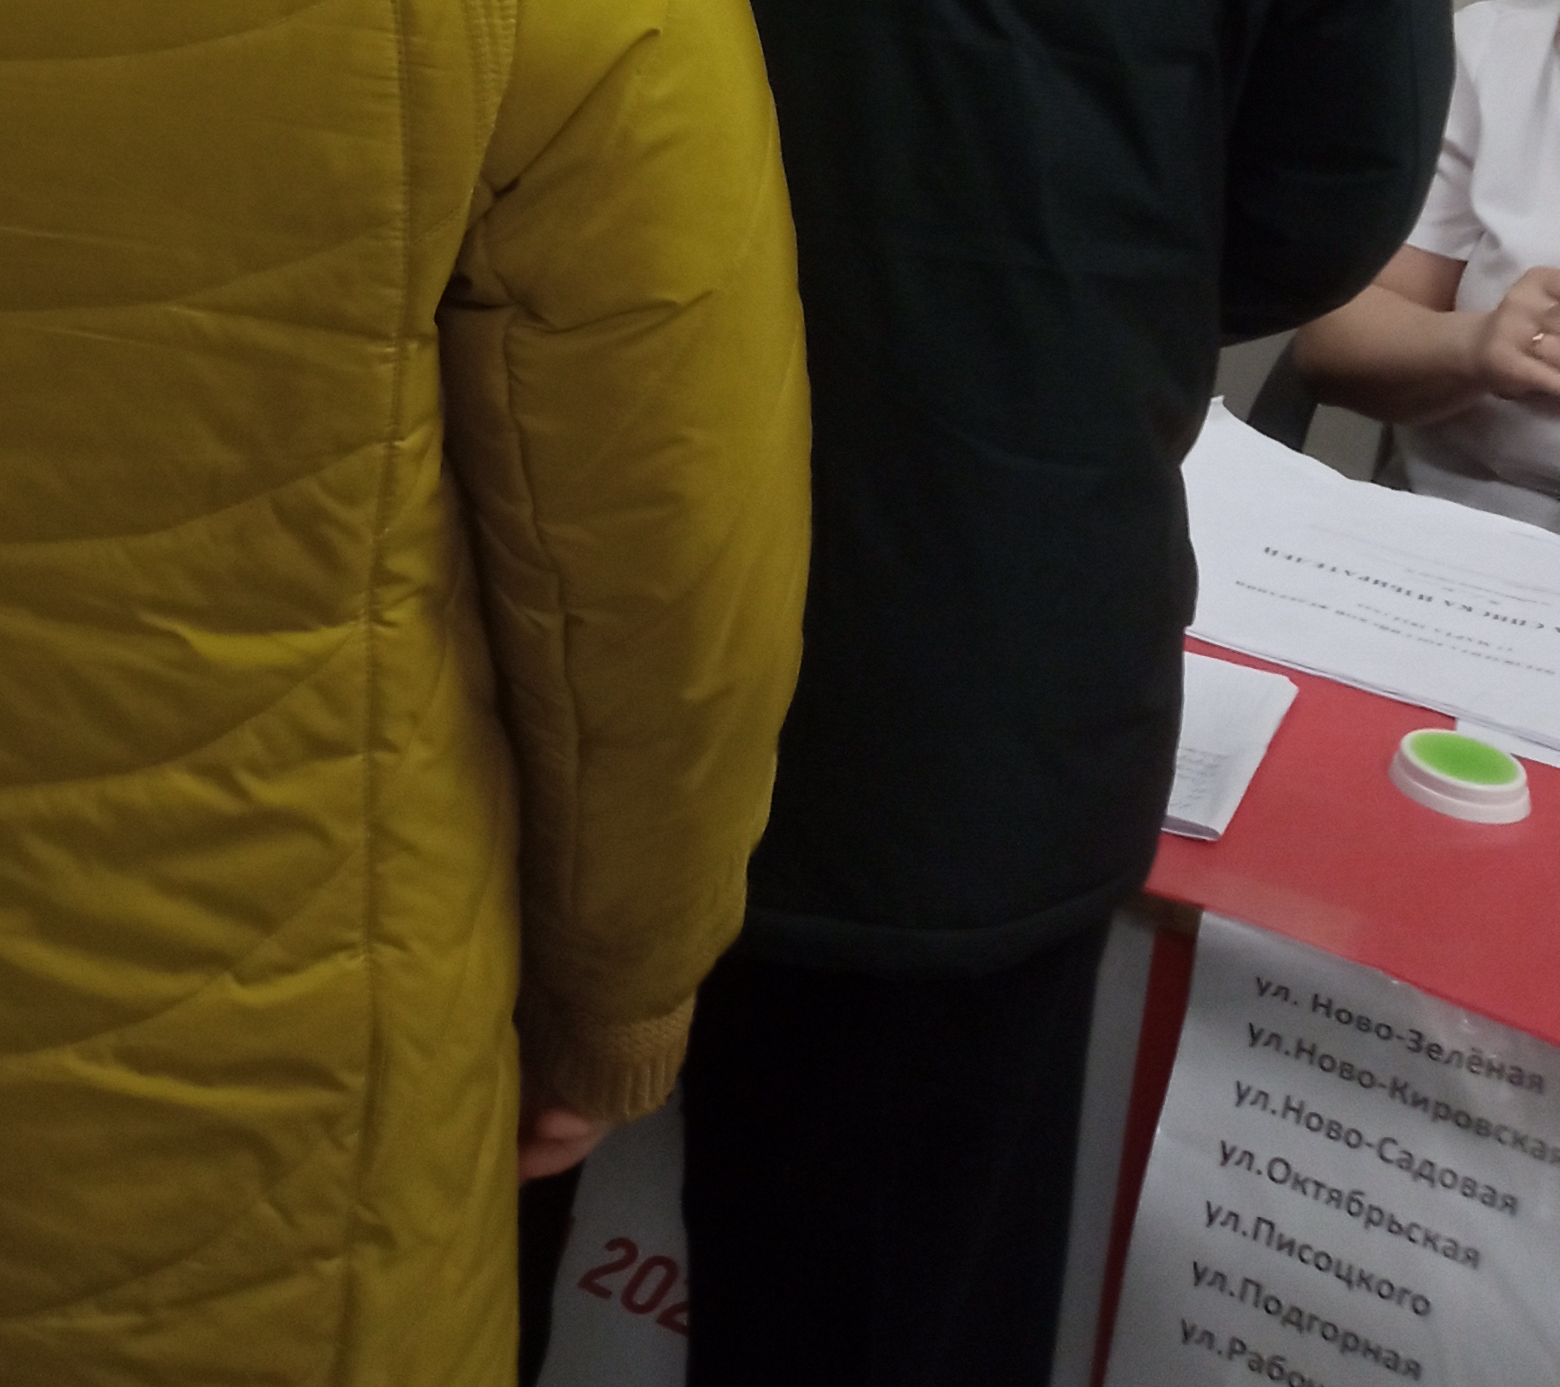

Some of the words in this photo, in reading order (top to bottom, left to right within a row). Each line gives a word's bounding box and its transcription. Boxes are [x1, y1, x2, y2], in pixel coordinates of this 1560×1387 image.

[1256, 976, 1298, 1006] ул.
[1312, 993, 1546, 1095] Ново-Зелёная
[1219, 1139, 1482, 1271] ул.Октябрьская
[1234, 1080, 1519, 1218] ул.Ново-Садовая
[1204, 1200, 1432, 1319] ул.Писоцкого
[1180, 1318, 1324, 1387] ул.Рабо
[1192, 1260, 1423, 1383] ул.Подгорная
